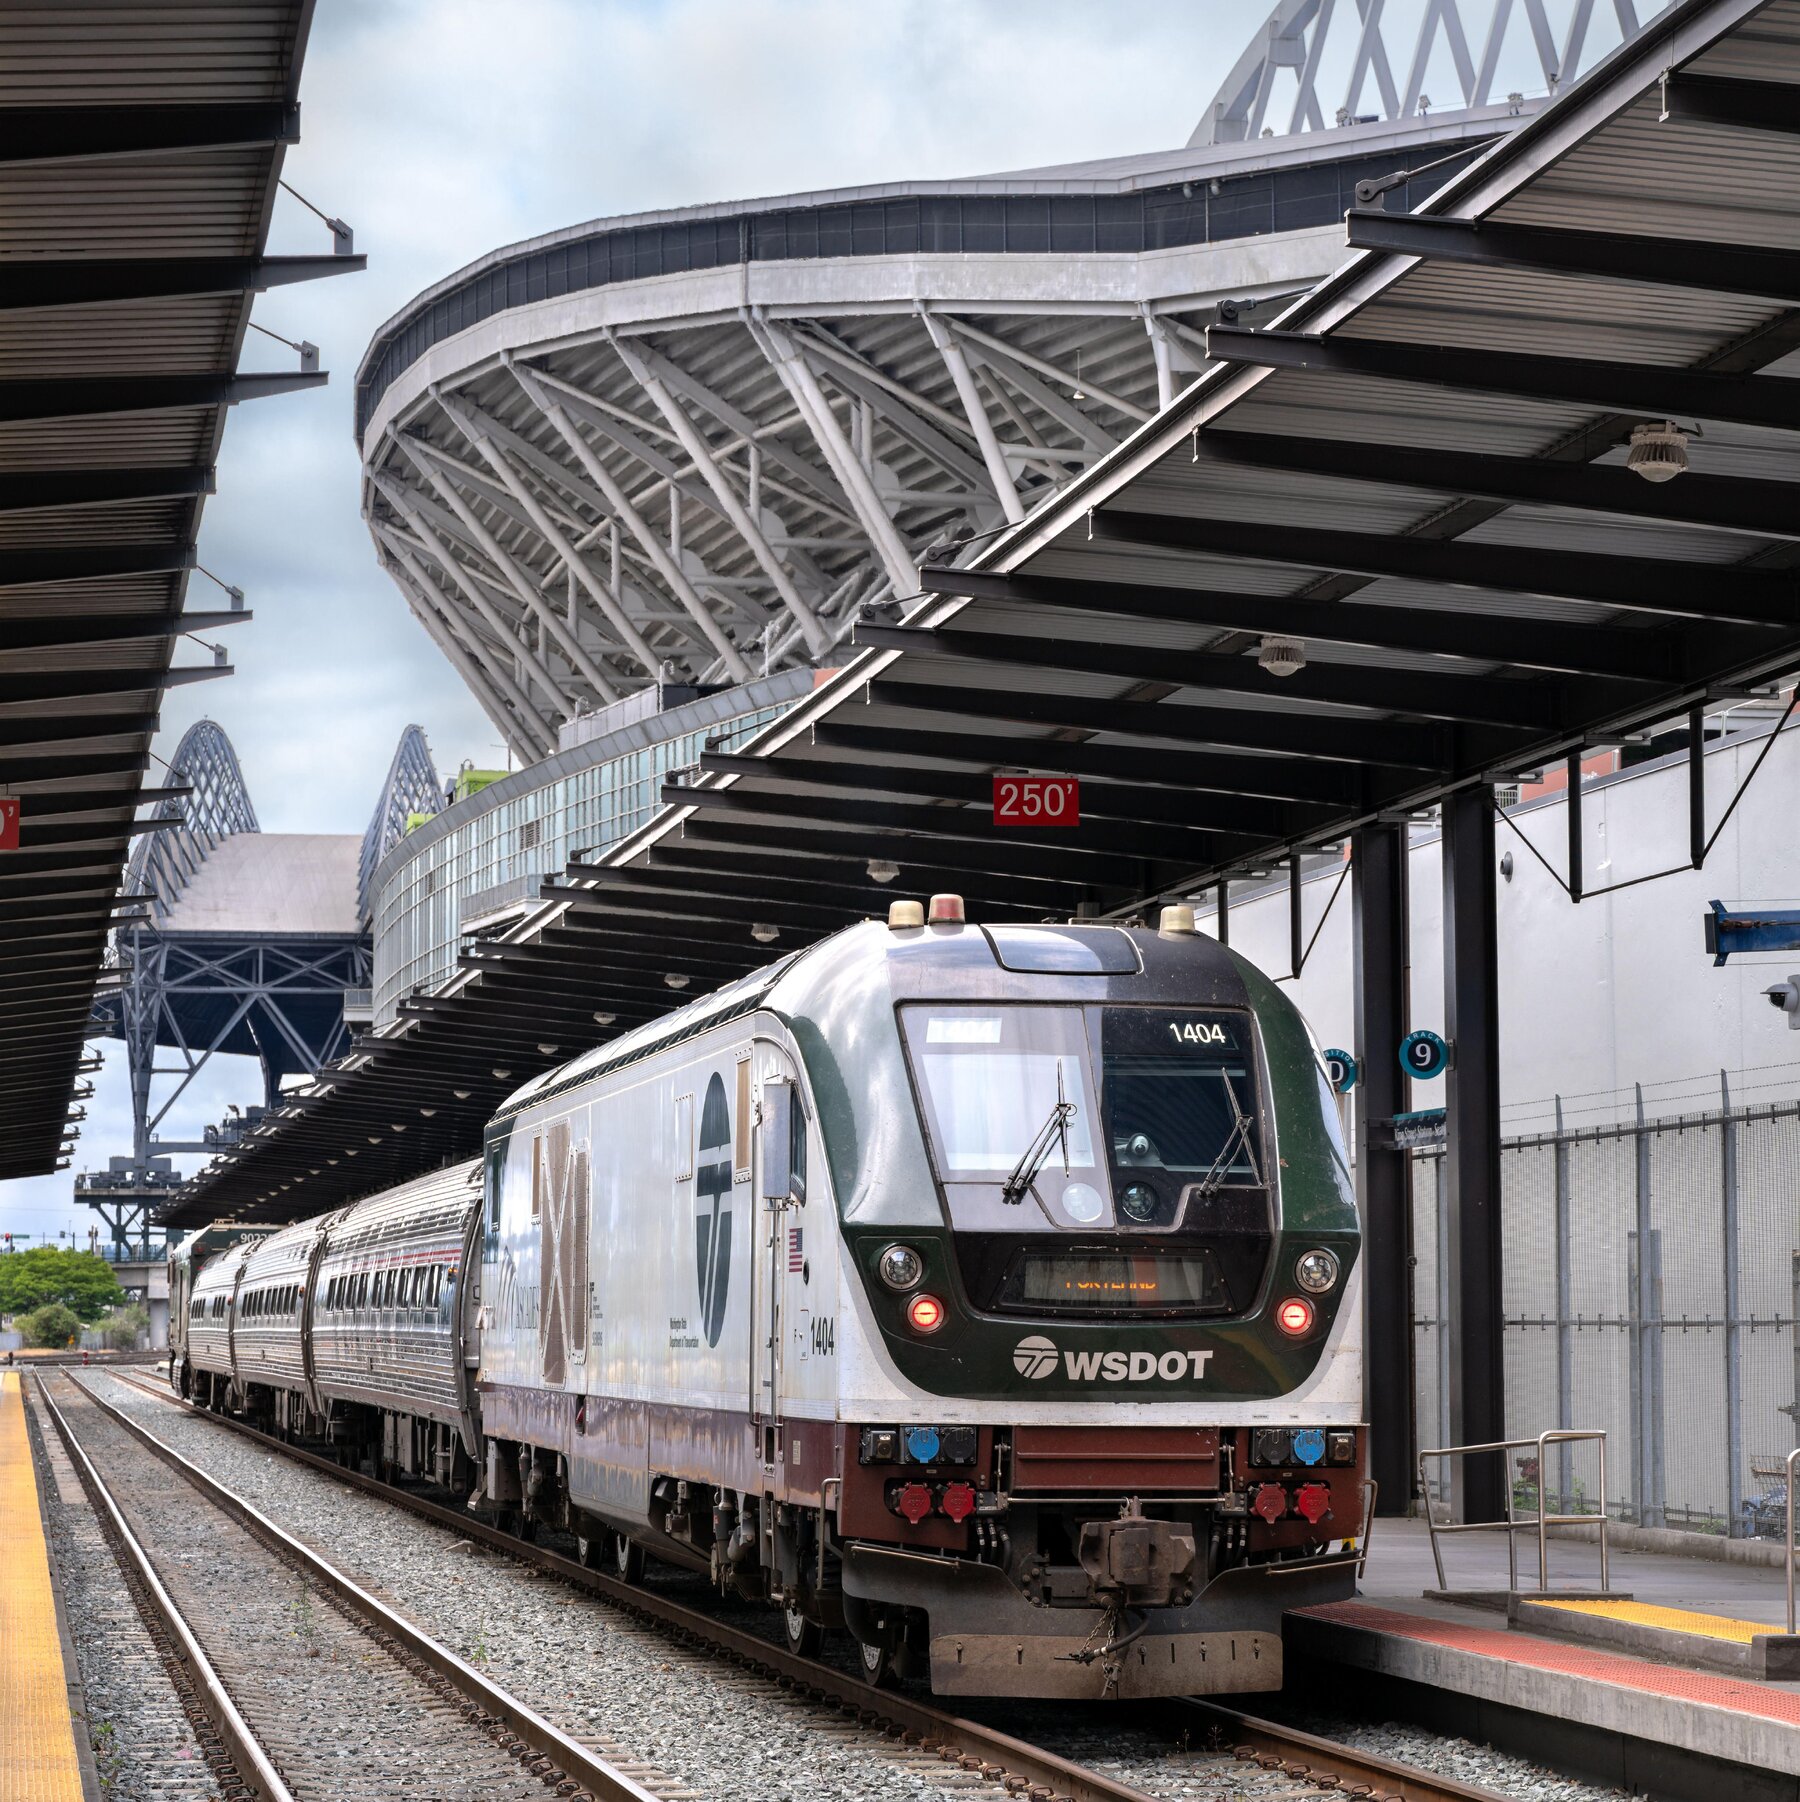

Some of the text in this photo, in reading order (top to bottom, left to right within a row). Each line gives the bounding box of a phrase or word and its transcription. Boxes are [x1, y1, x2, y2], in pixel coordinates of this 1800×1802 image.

[1000, 783, 1073, 816] 250'
[1169, 1023, 1226, 1043] 1404
[1406, 1031, 1441, 1045] TRACK
[1324, 1050, 1355, 1068] SITION
[1415, 1043, 1431, 1066] 9
[1326, 1060, 1344, 1082] D
[811, 1317, 834, 1356] 1404
[1064, 1350, 1214, 1381] WSDOT
